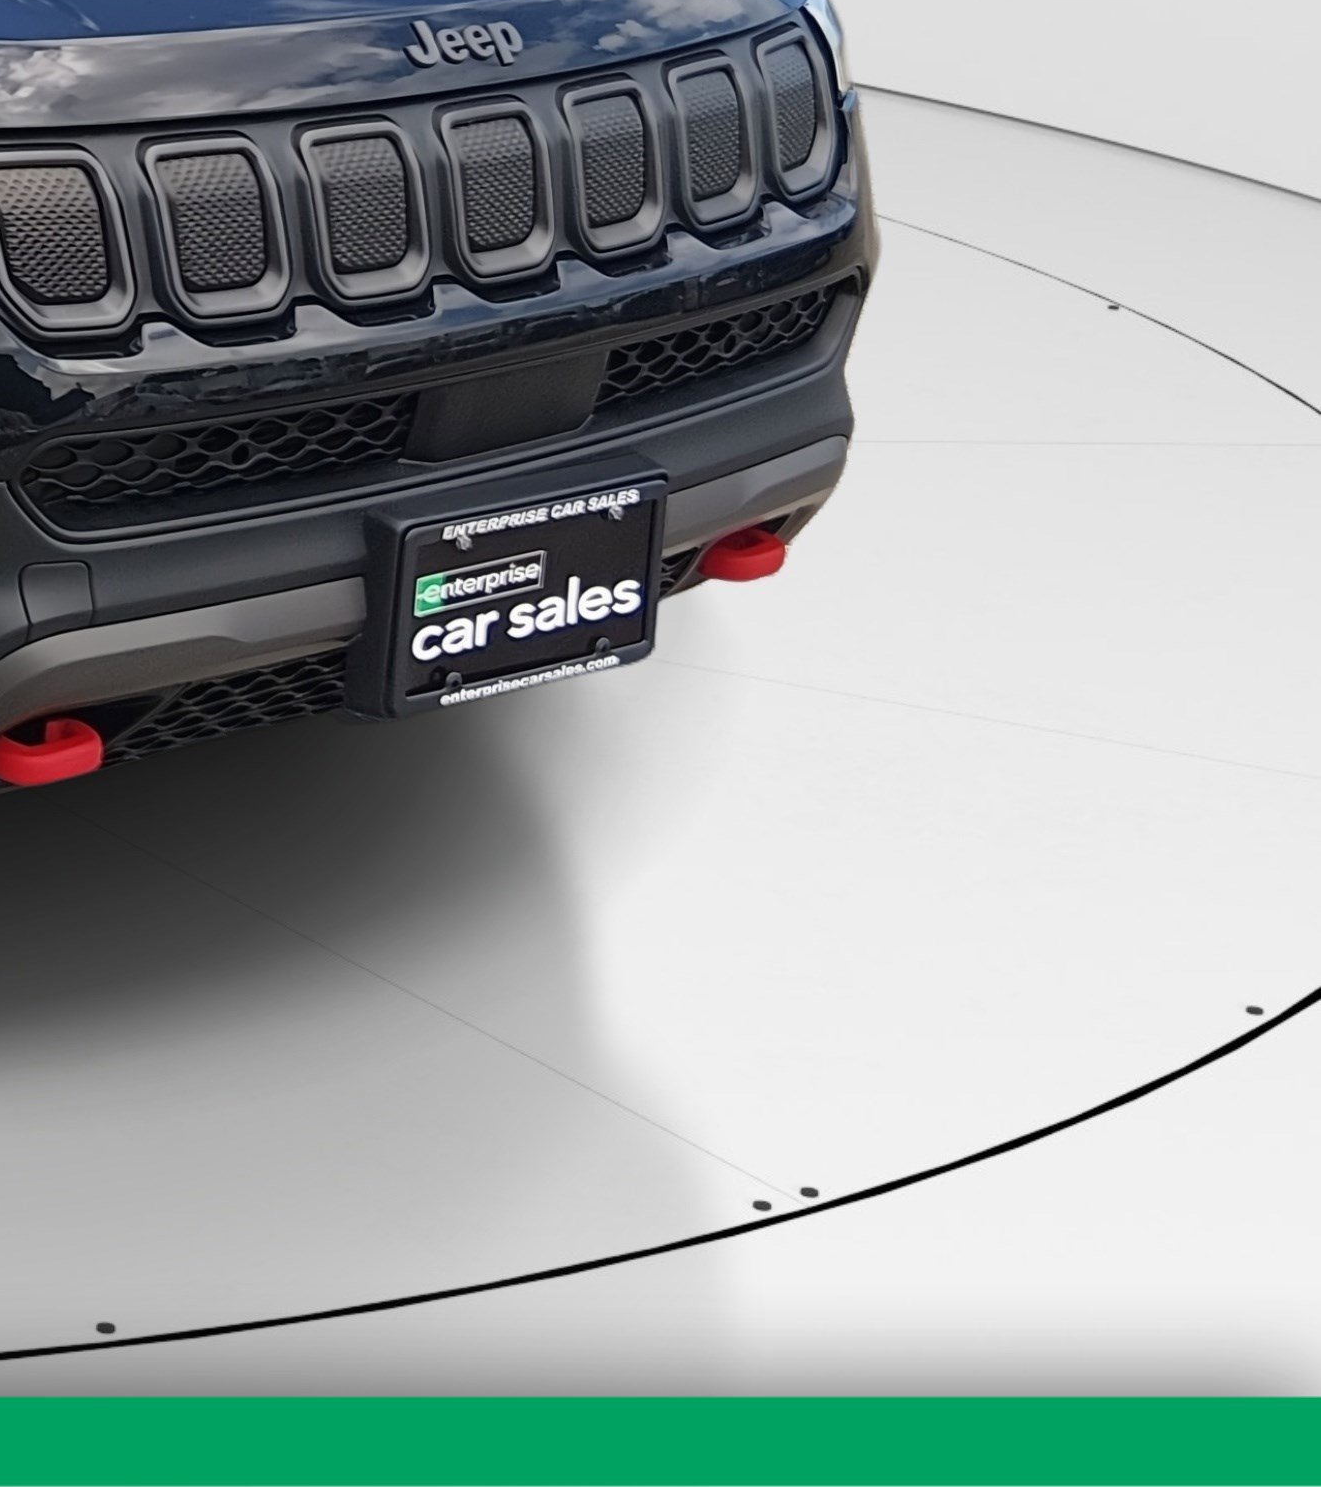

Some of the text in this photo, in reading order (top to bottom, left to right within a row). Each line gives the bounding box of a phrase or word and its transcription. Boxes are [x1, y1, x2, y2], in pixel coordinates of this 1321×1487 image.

[404, 20, 524, 67] Jeep
[441, 488, 640, 541] ENTERPRISE CAR SALES
[422, 563, 541, 602] enterprise
[411, 575, 643, 661] car sales
[439, 654, 620, 706] enterprisecarsales.com
